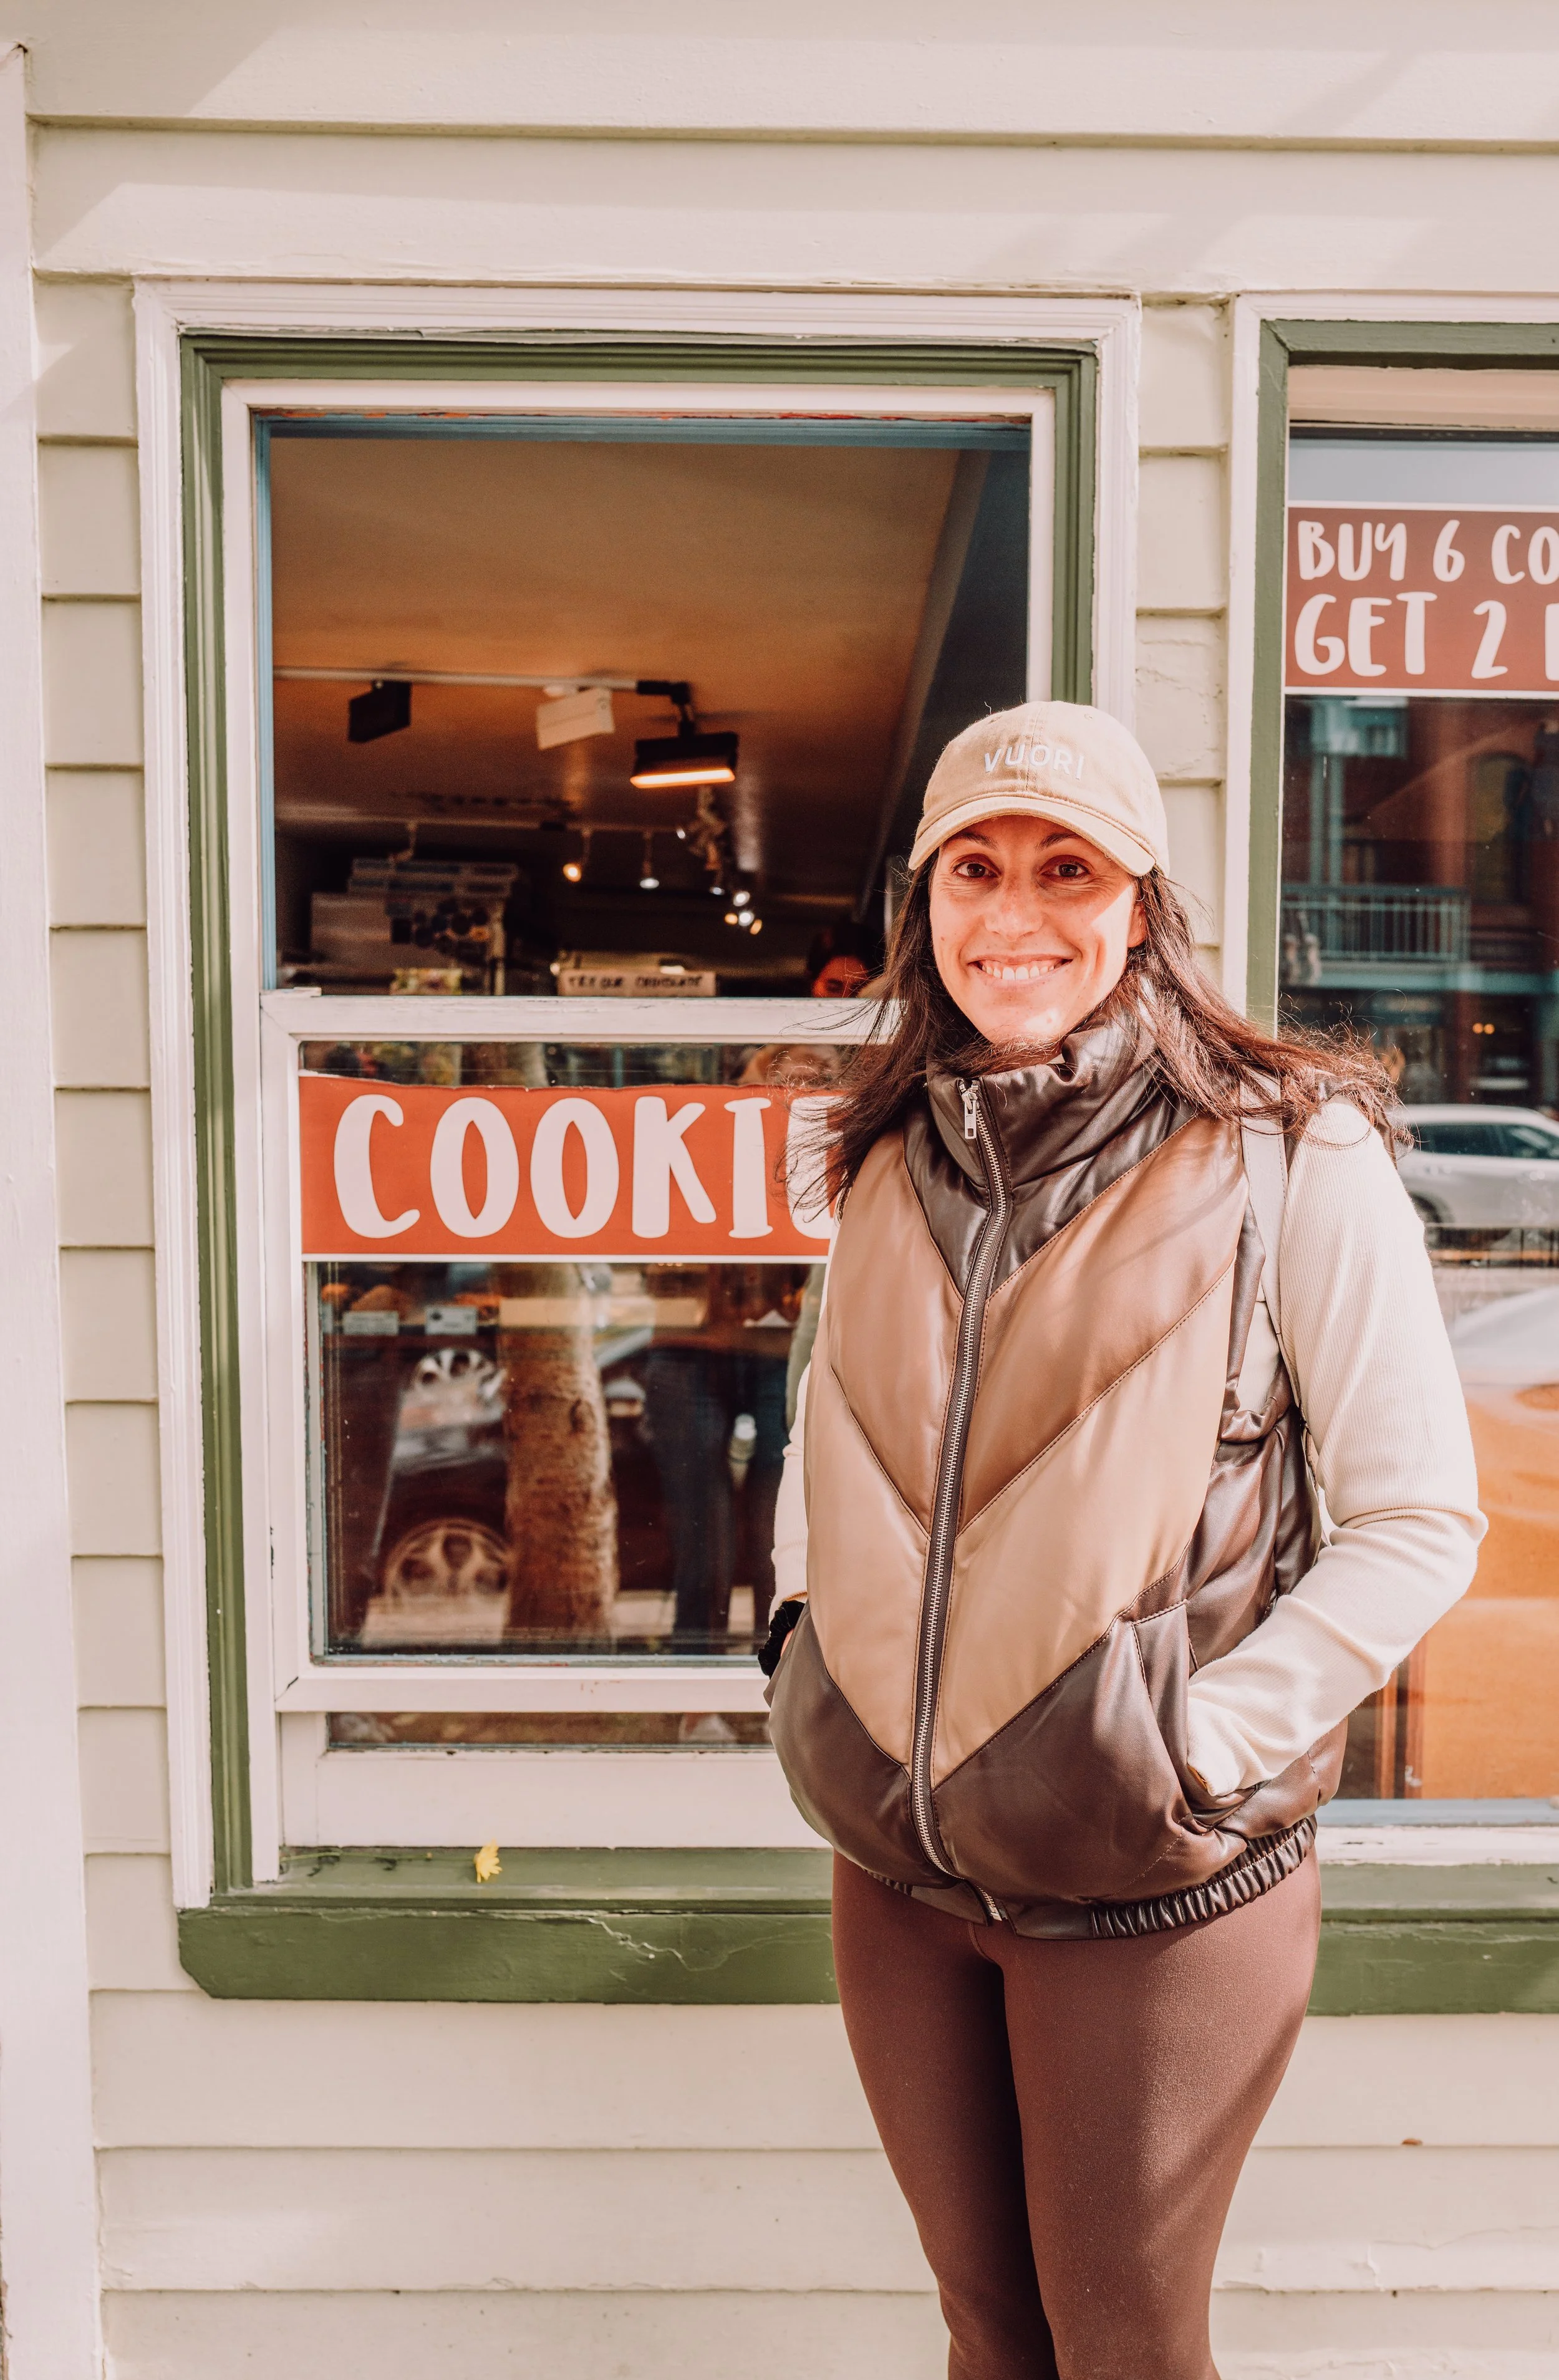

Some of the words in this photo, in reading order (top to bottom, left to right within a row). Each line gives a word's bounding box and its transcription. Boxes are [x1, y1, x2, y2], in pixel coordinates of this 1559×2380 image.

[1298, 520, 1407, 581] BUY
[1433, 519, 1465, 582] 6
[1491, 524, 1559, 585] CO
[1294, 592, 1438, 677] GET
[1471, 600, 1508, 679] 2
[983, 744, 1084, 780] VUORI
